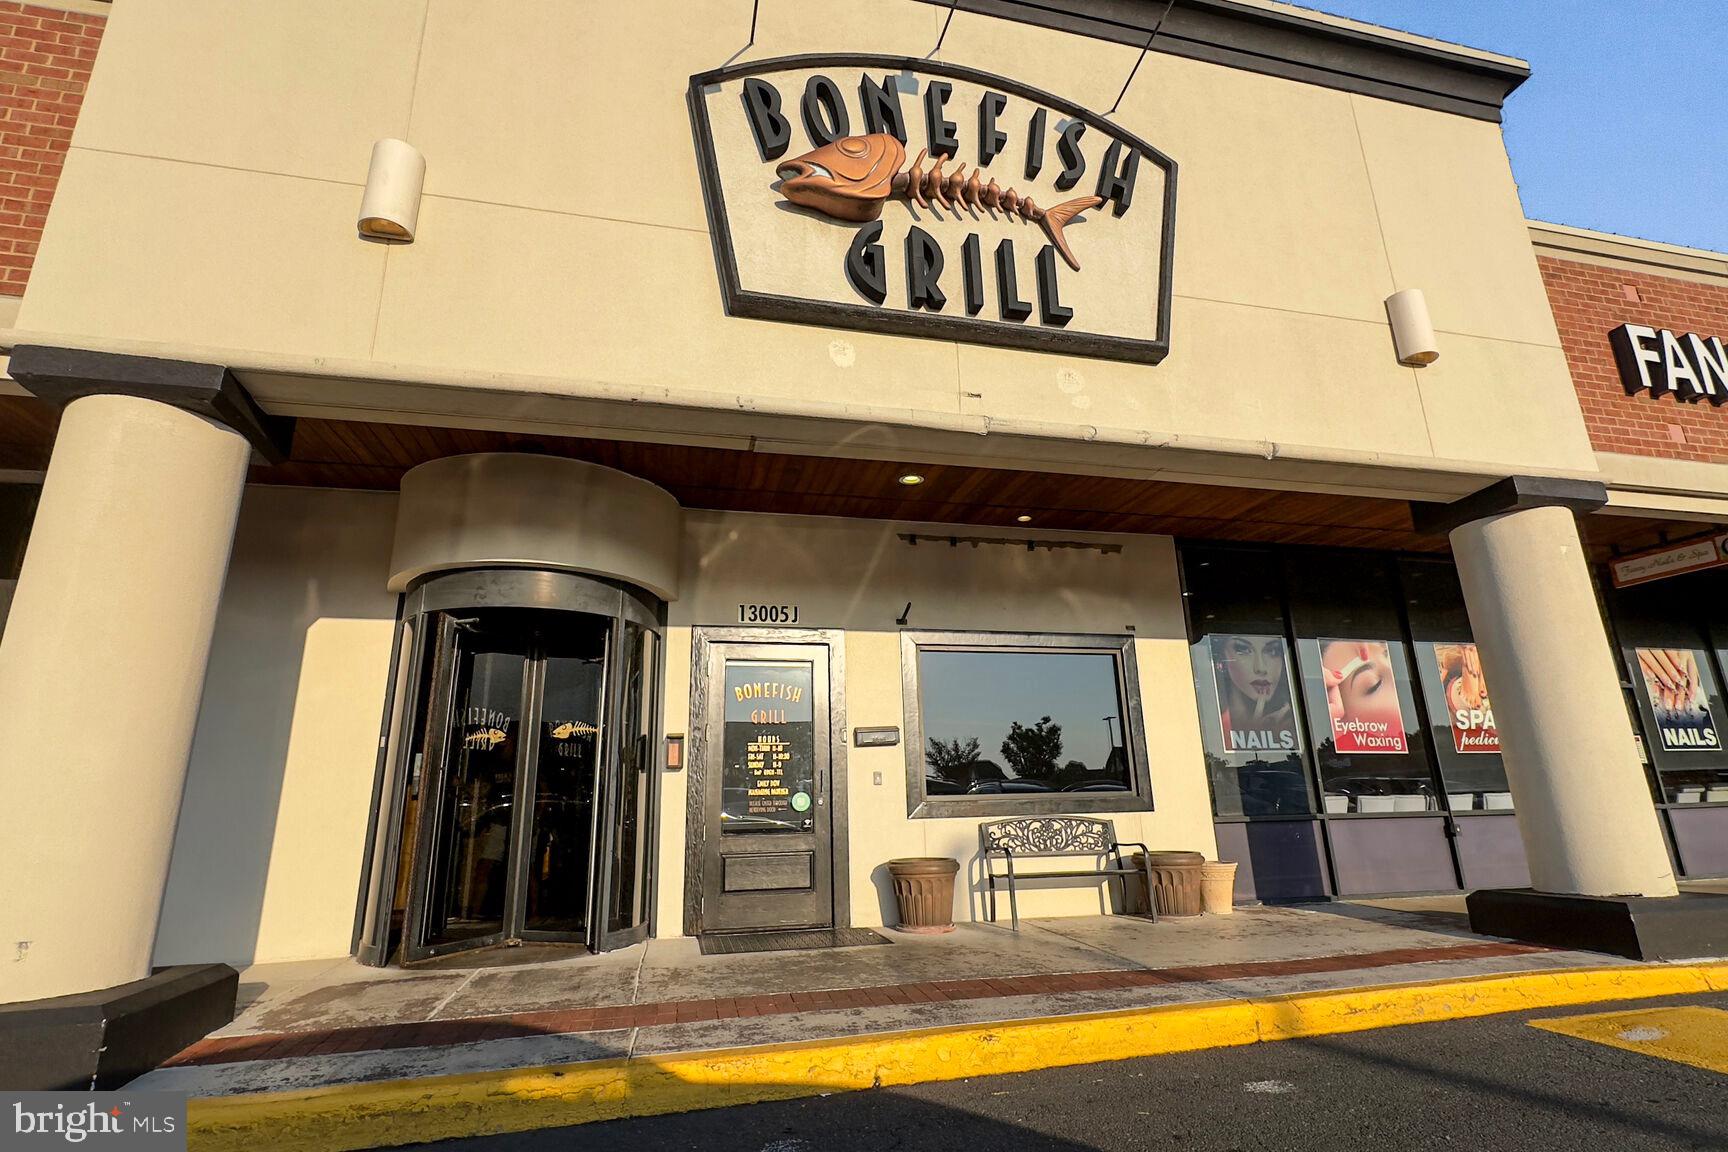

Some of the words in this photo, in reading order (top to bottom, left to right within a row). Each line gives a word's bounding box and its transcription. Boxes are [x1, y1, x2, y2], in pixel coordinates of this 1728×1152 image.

[741, 72, 1141, 218] BONEFISH
[846, 220, 1074, 327] GRILL
[734, 682, 803, 703] BONEFISH
[750, 708, 788, 725] GRILL
[1455, 709, 1497, 730] SPA
[1334, 717, 1388, 736] Eyebrow
[1230, 730, 1295, 749] NAILS
[1353, 732, 1402, 751] Waxing
[1663, 728, 1718, 747] NAILS
